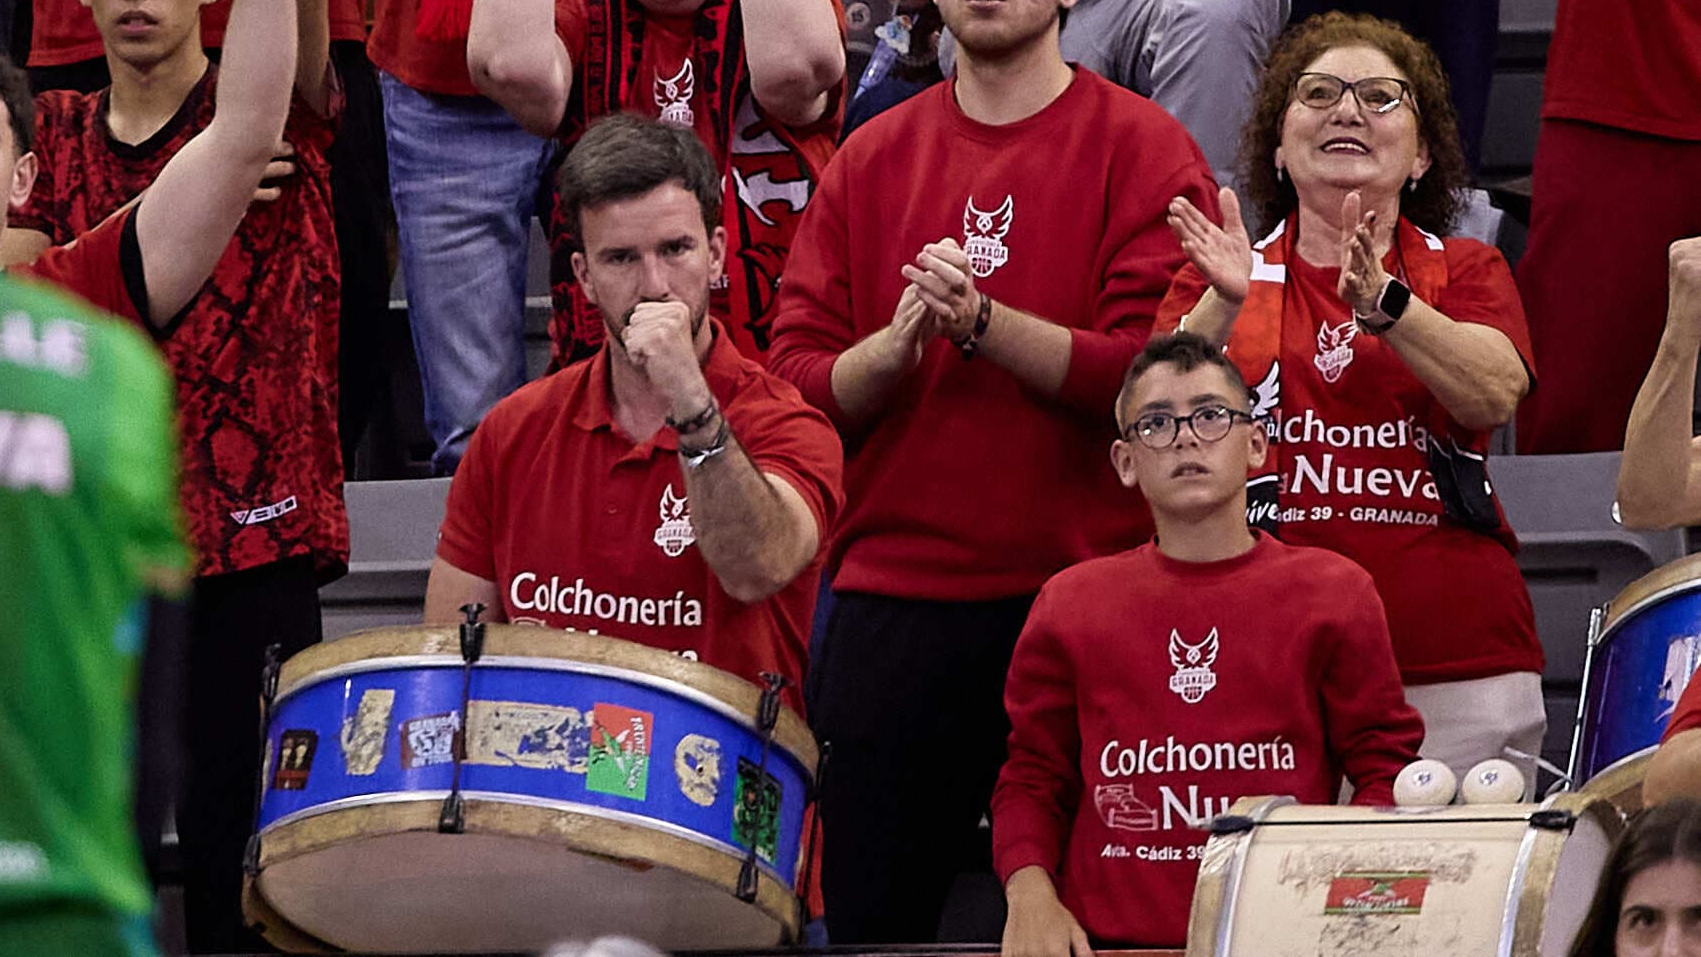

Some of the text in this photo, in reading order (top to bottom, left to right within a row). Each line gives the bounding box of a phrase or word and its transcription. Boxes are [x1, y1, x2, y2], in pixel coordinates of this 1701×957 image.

[1309, 506, 1332, 521] 39
[1349, 506, 1440, 528] GRANADA
[509, 571, 703, 627] Colchonería
[1099, 735, 1296, 778] Colchonería
[1135, 845, 1182, 862] Cádiz
